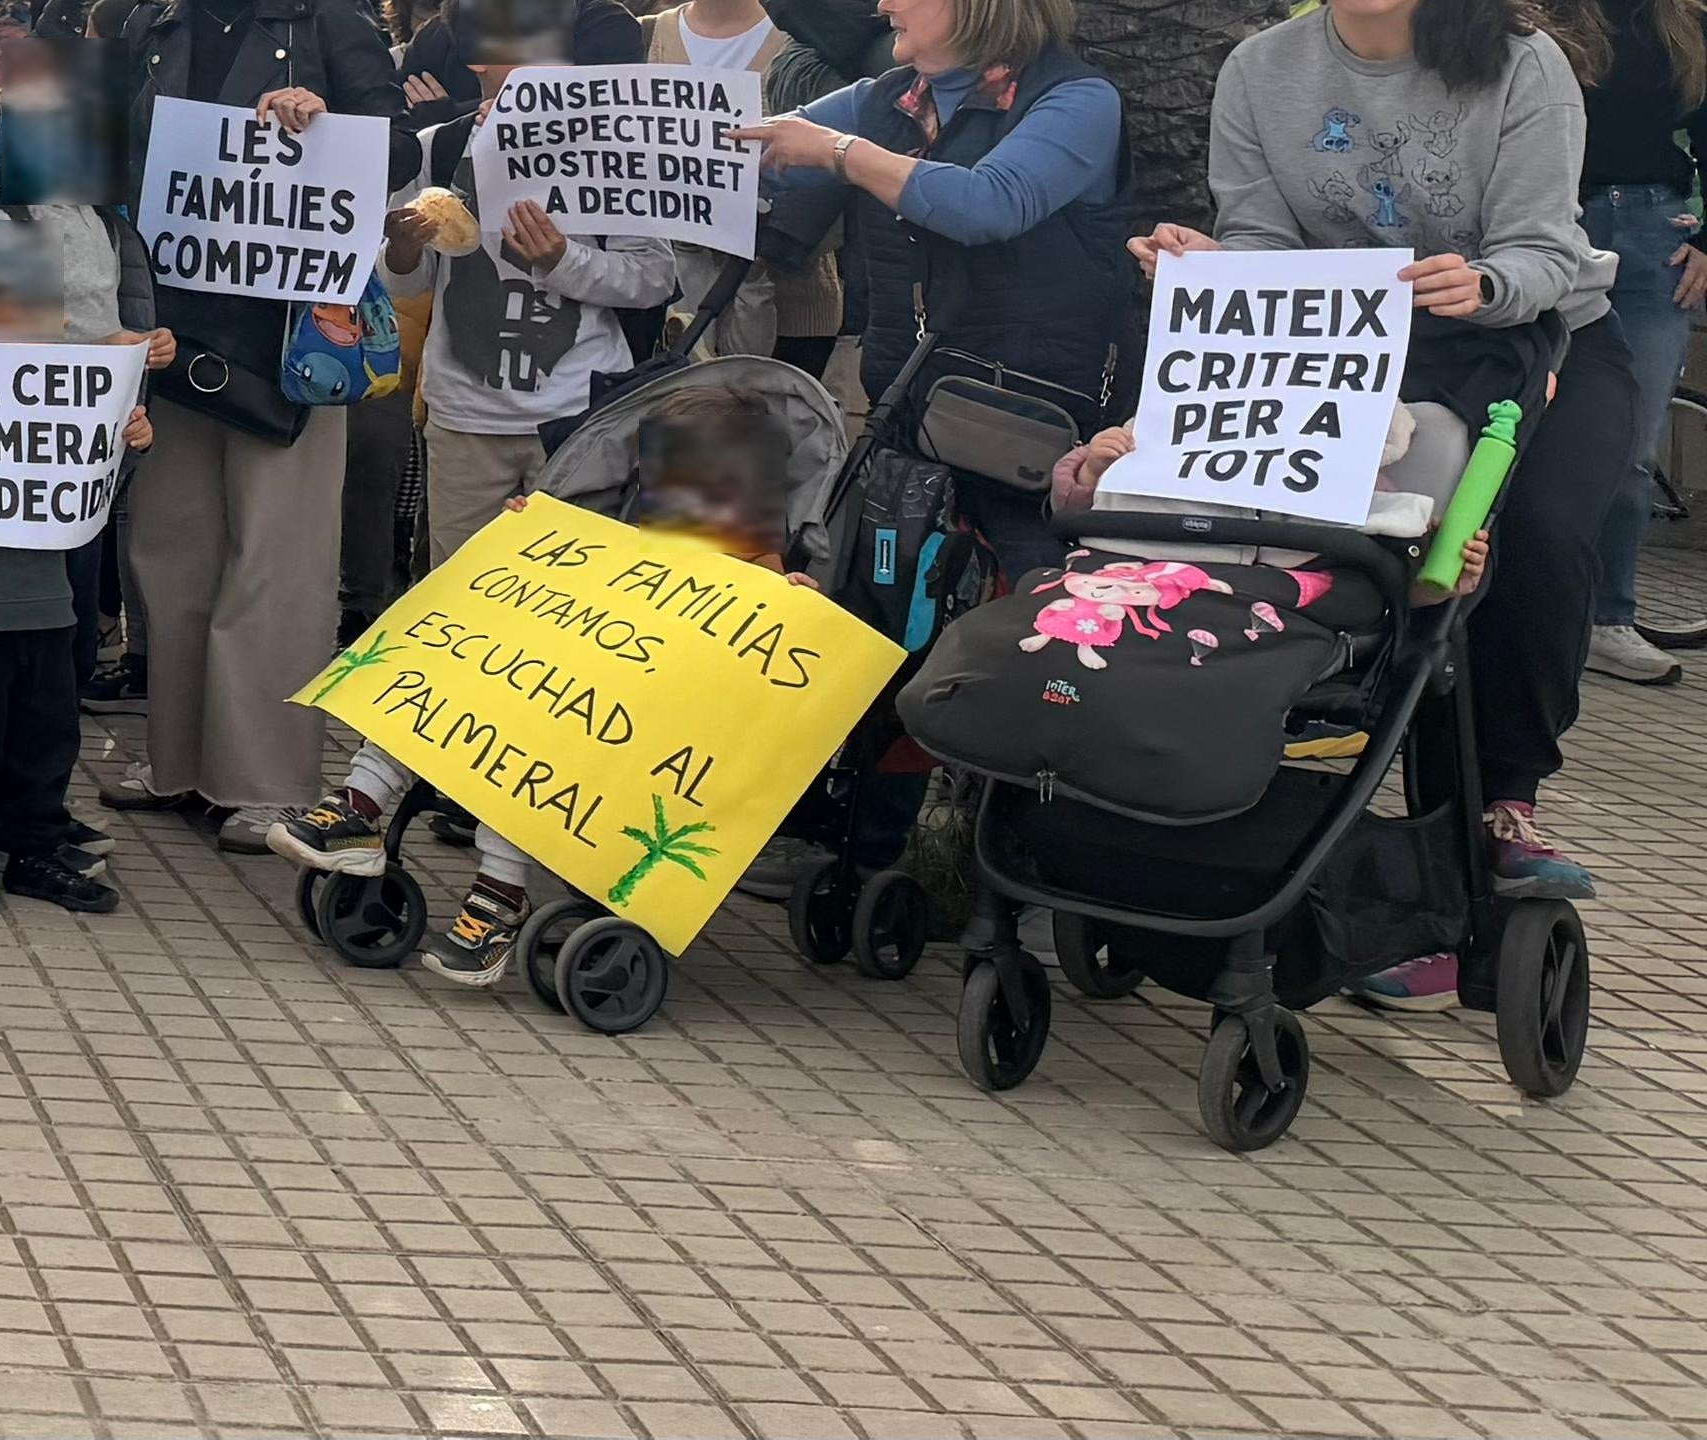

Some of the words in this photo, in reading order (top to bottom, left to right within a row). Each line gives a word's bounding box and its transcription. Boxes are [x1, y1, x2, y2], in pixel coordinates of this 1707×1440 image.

[496, 78, 742, 118] CONSELLERIA,
[219, 117, 303, 166] LES
[497, 114, 700, 152] RESPECTEU
[712, 121, 751, 154] EL
[508, 150, 647, 181] NOSTRE
[657, 153, 744, 192] DRET
[166, 167, 355, 235] FAMÍLIES
[545, 185, 569, 215] A
[578, 185, 713, 226] DECIDIR
[152, 231, 357, 295] COMPTEM
[1169, 287, 1388, 337] MATEIX
[12, 364, 113, 408] CEIP
[1156, 349, 1391, 394] CRITERI
[1170, 399, 1283, 446] PER
[1299, 401, 1341, 439] A
[1177, 448, 1324, 494] TOTS
[468, 566, 665, 673] CONTAMOS,
[519, 529, 607, 568] LAS
[608, 558, 821, 689] FAMILIAS
[404, 611, 633, 745] ESCUCHAD
[650, 745, 715, 808] AL
[372, 670, 604, 848] PALMERAL
